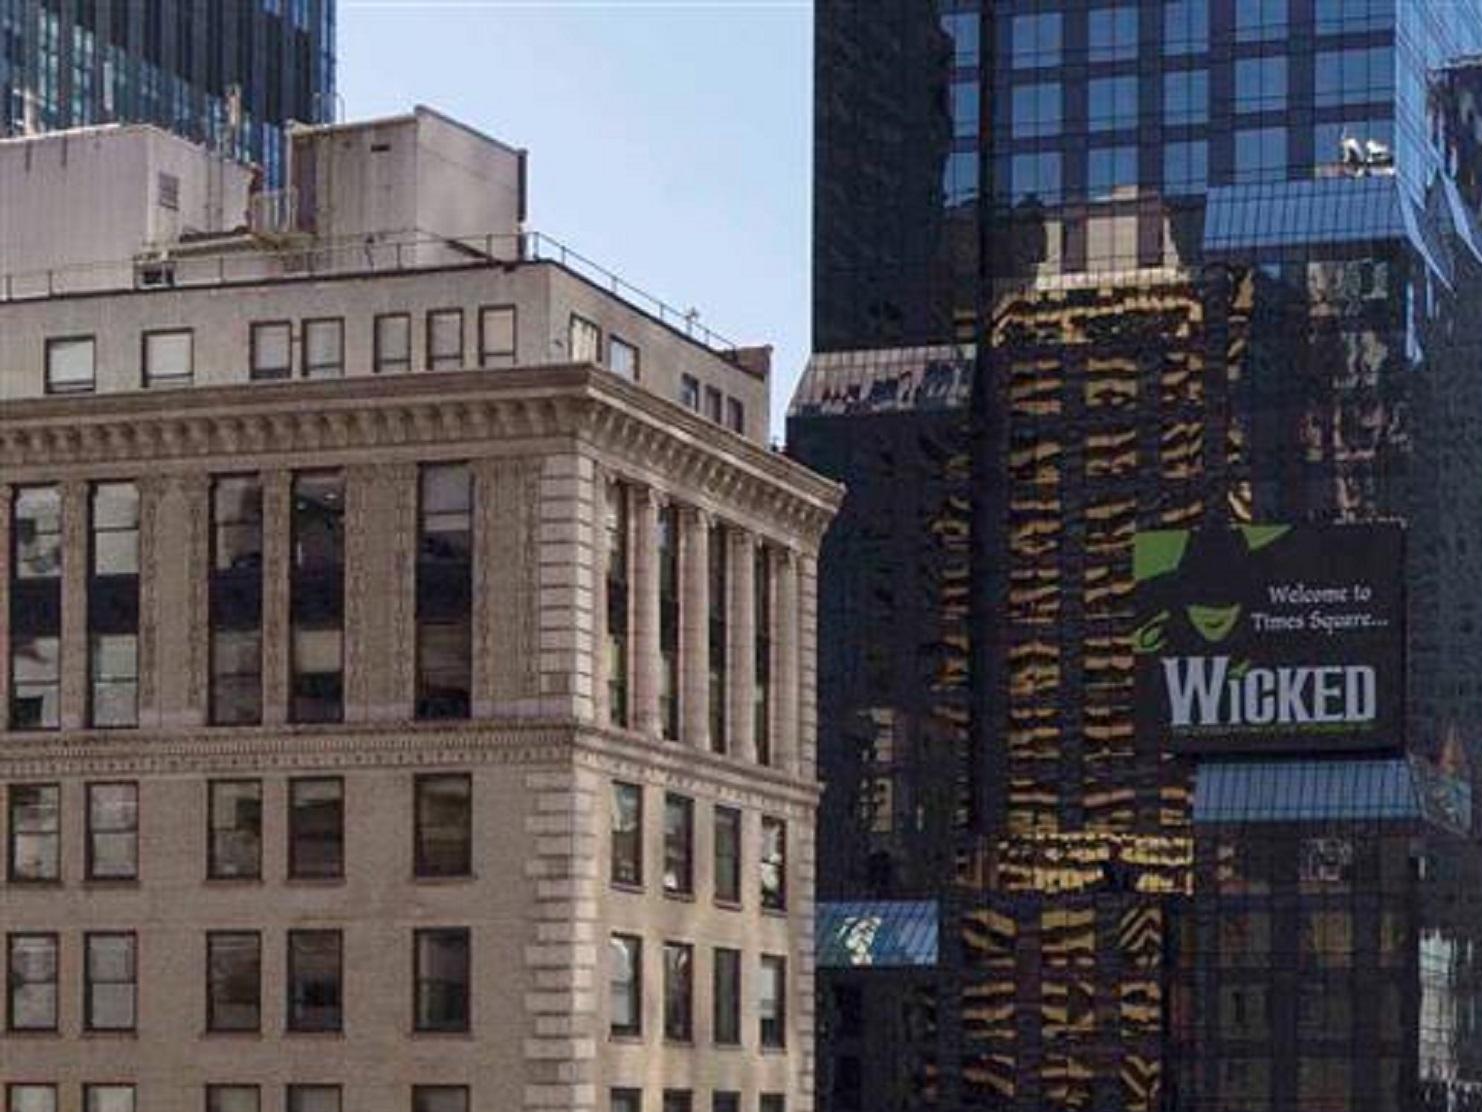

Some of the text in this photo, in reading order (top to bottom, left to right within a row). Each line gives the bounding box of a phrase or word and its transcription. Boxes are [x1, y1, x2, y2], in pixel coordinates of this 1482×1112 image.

[1268, 579, 1372, 604] Welcome to
[1251, 613, 1305, 631] Times
